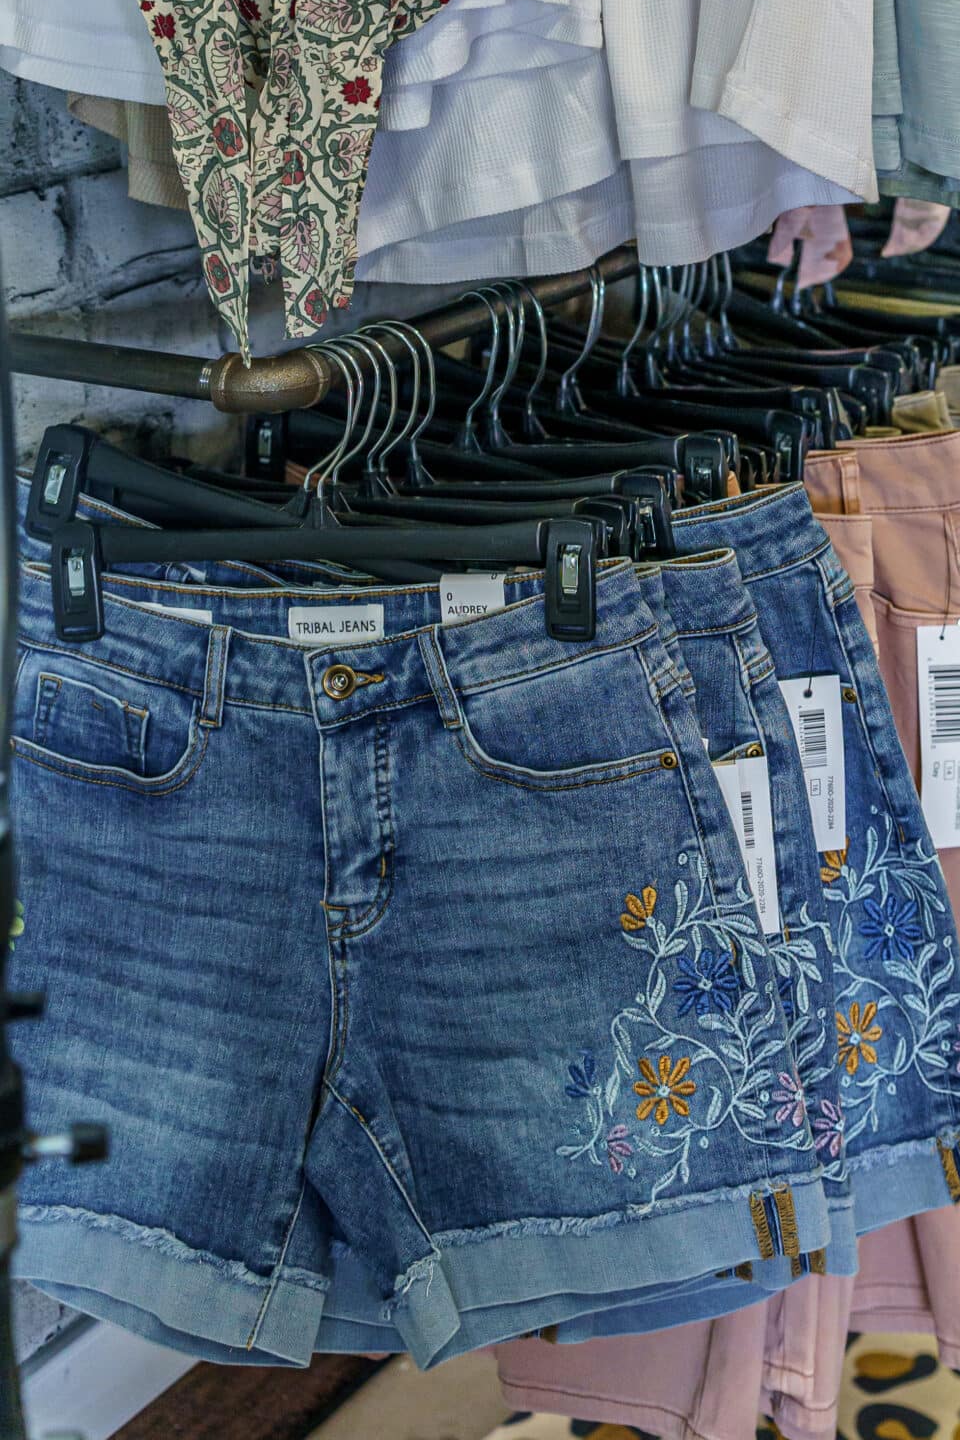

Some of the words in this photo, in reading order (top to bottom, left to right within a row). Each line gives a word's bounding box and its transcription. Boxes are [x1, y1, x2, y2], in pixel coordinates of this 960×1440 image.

[448, 605, 488, 615] AUDREY
[296, 622, 335, 634] TRIBAL
[339, 620, 376, 633] JEANS
